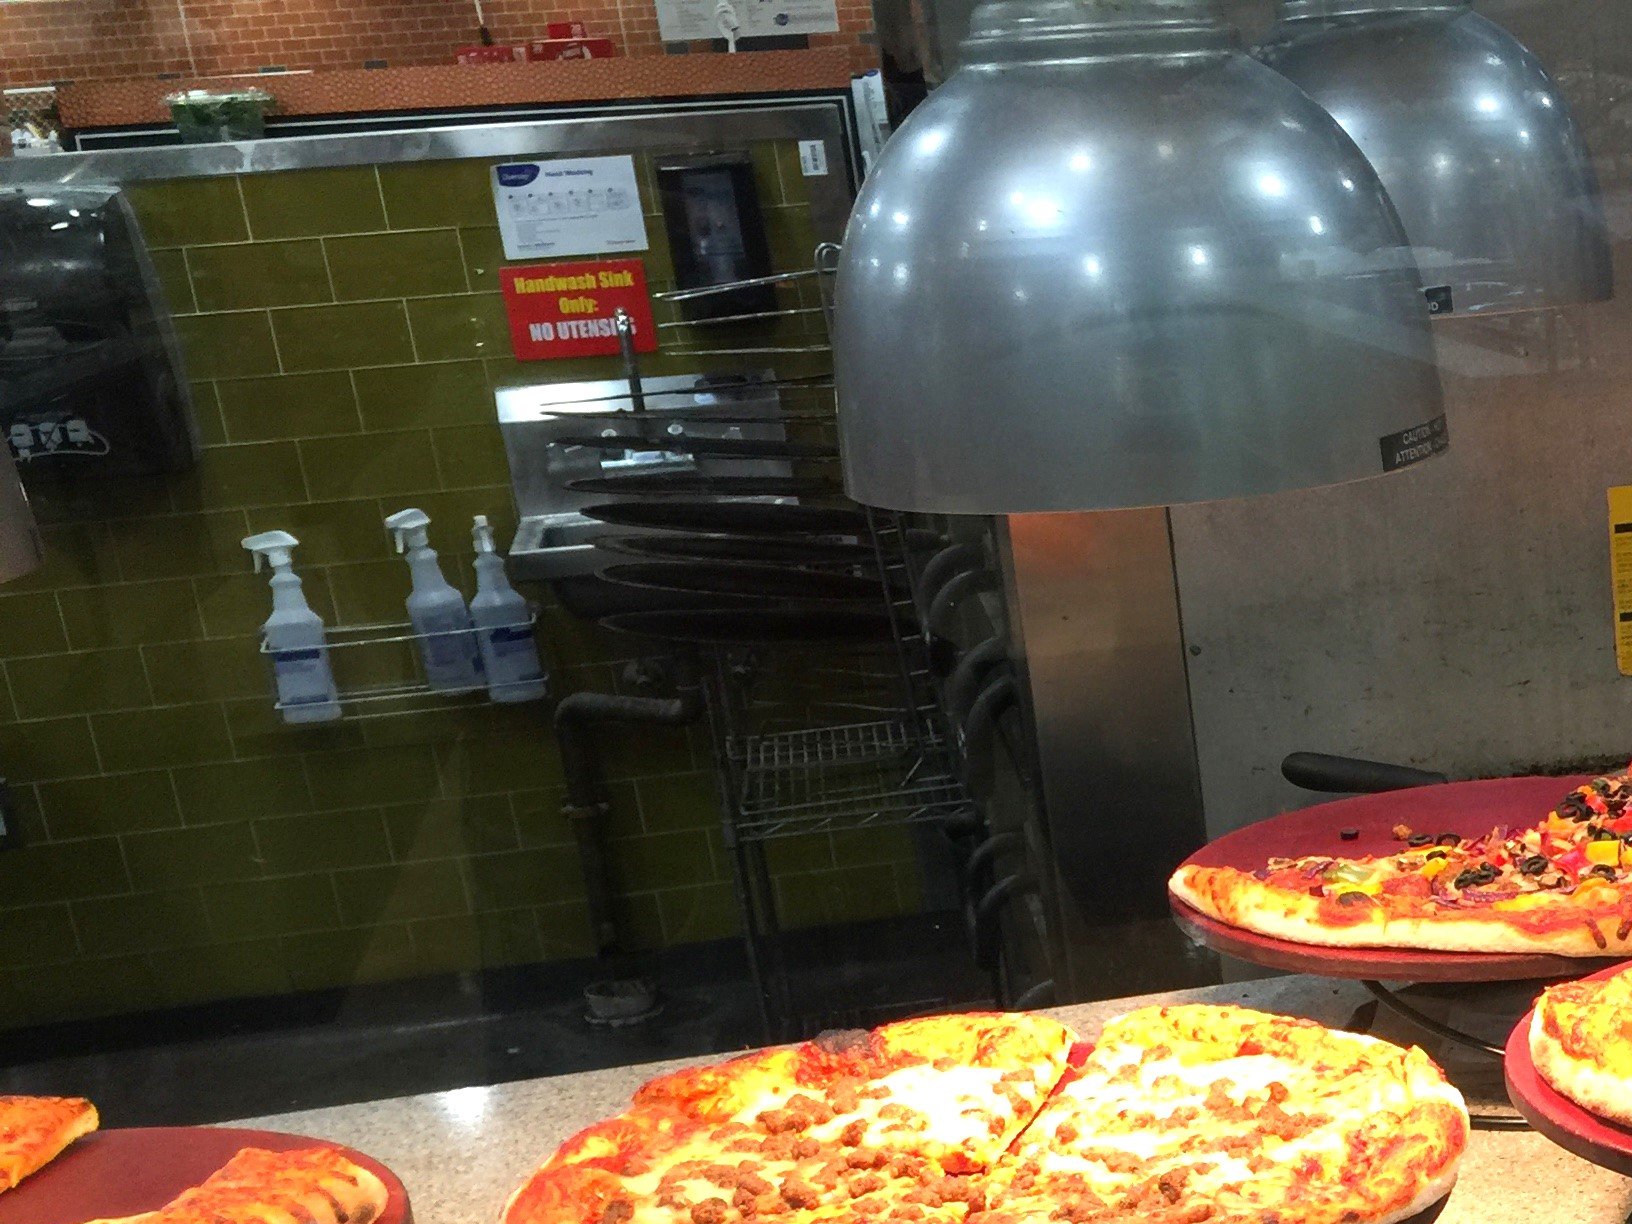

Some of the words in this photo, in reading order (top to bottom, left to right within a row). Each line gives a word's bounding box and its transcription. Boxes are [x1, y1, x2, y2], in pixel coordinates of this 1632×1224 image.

[514, 273, 597, 294] Handwash
[598, 270, 635, 288] Sink
[558, 296, 599, 314] Only:
[528, 322, 554, 342] NO
